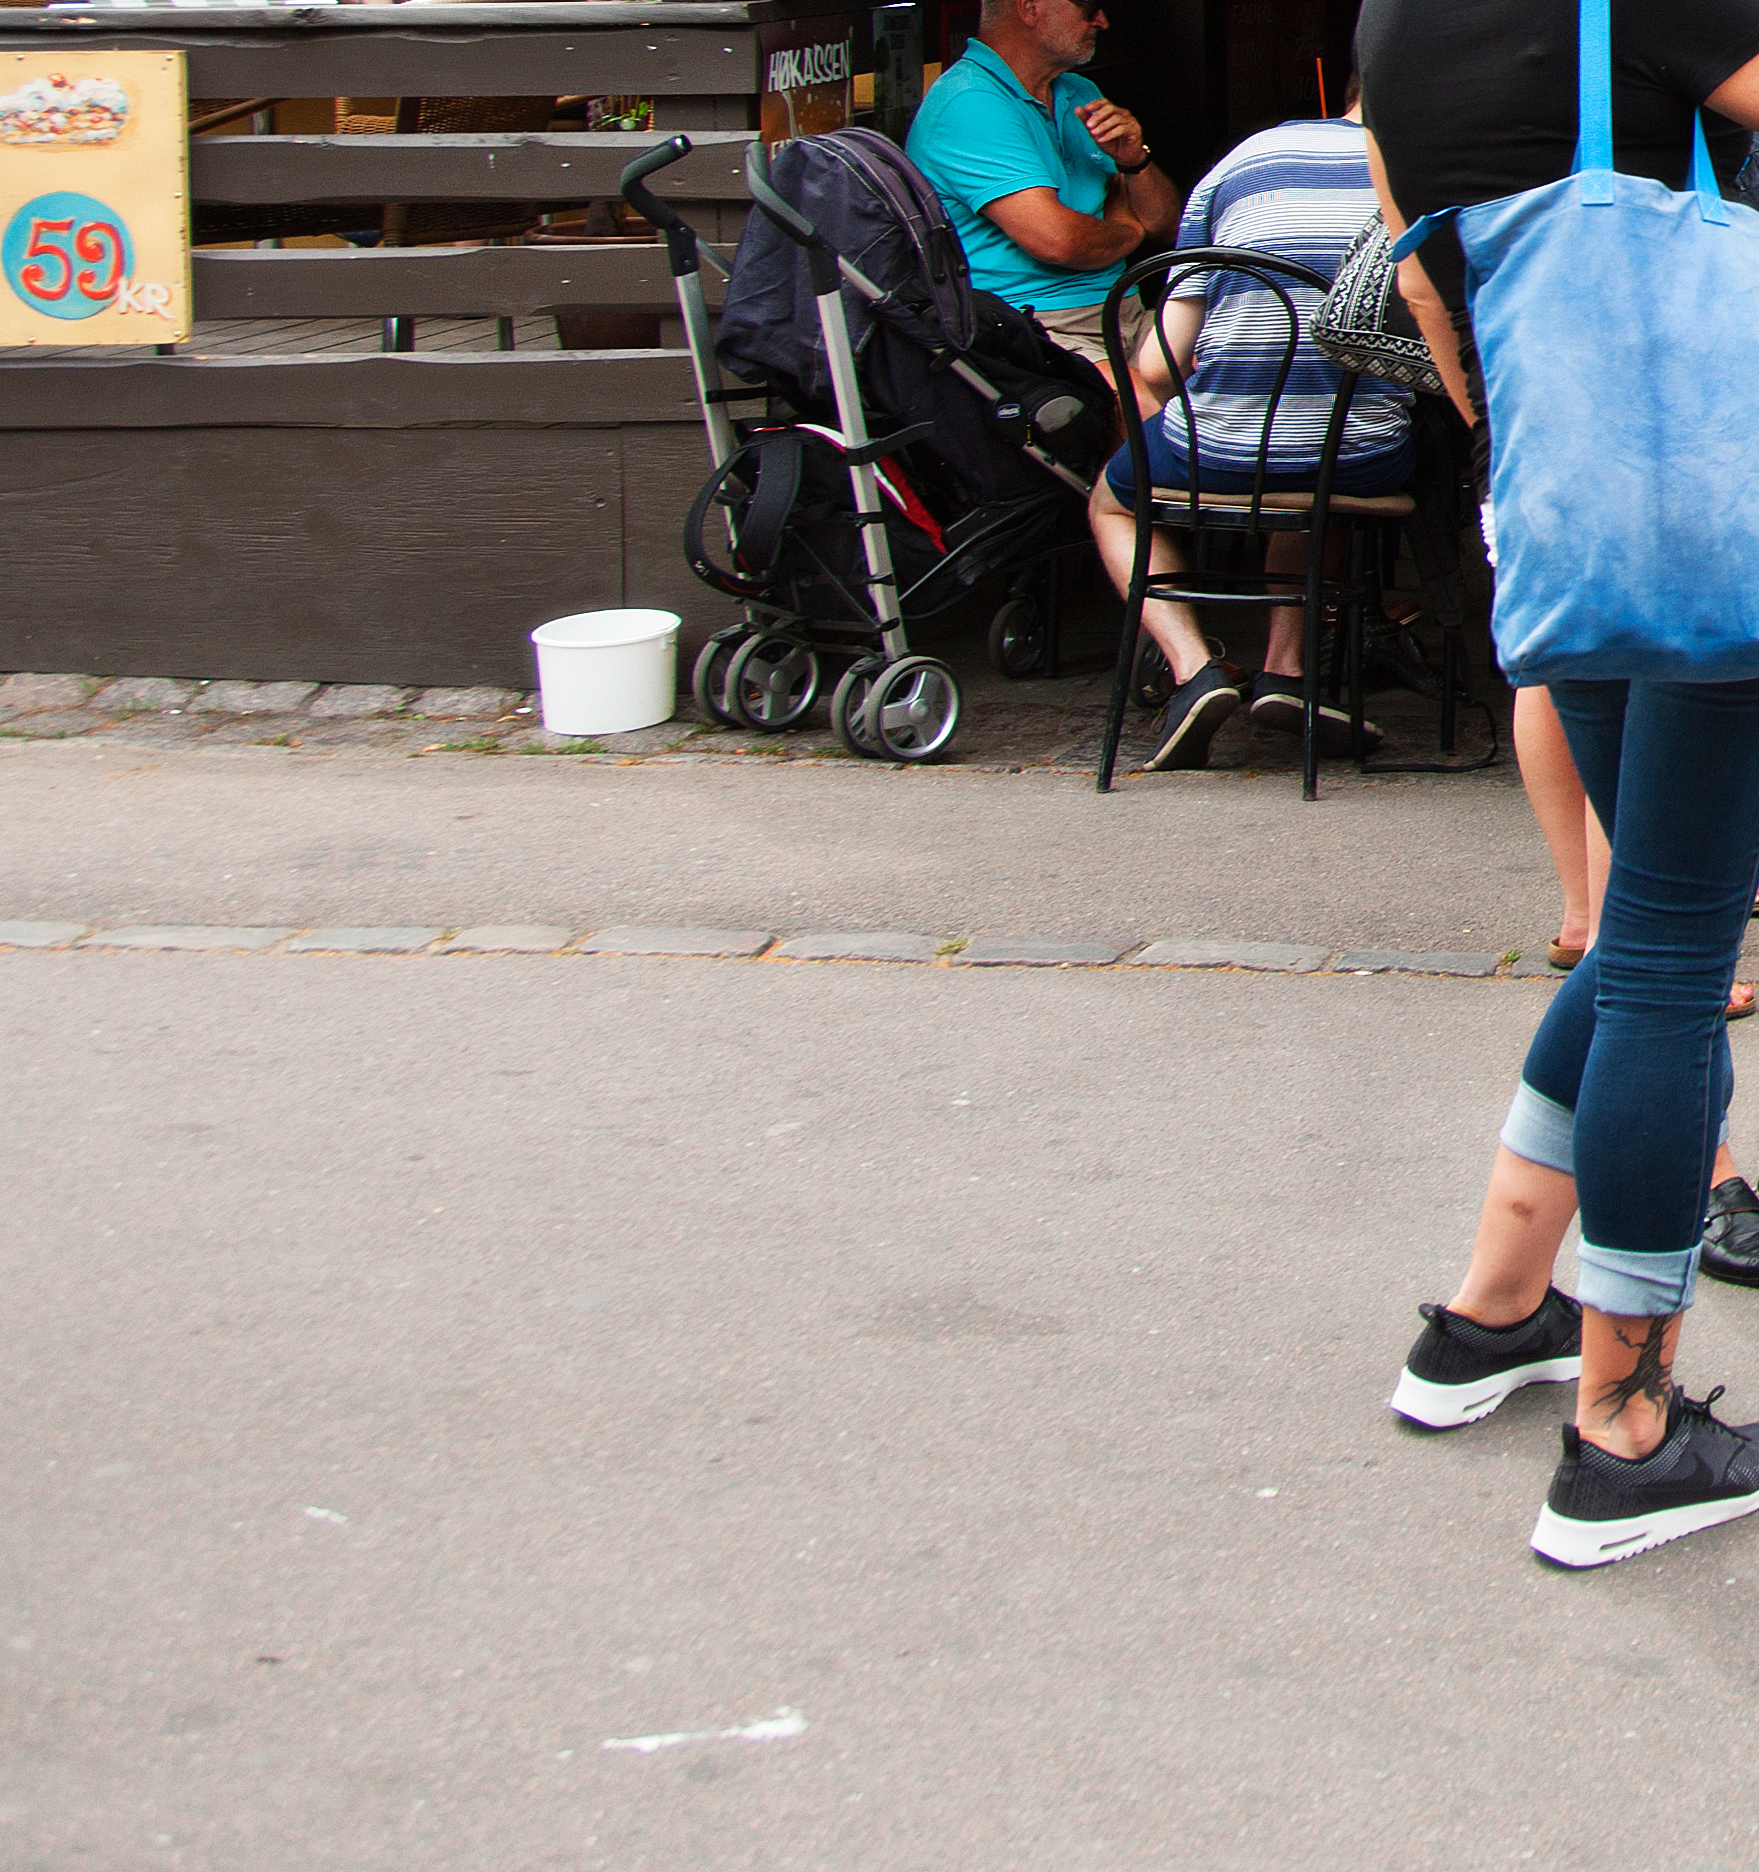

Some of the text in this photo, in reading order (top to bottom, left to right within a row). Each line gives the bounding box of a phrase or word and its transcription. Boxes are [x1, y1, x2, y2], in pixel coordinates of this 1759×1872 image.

[768, 39, 851, 93] HØKASSEN
[20, 216, 123, 301] 59
[116, 279, 174, 321] KR
